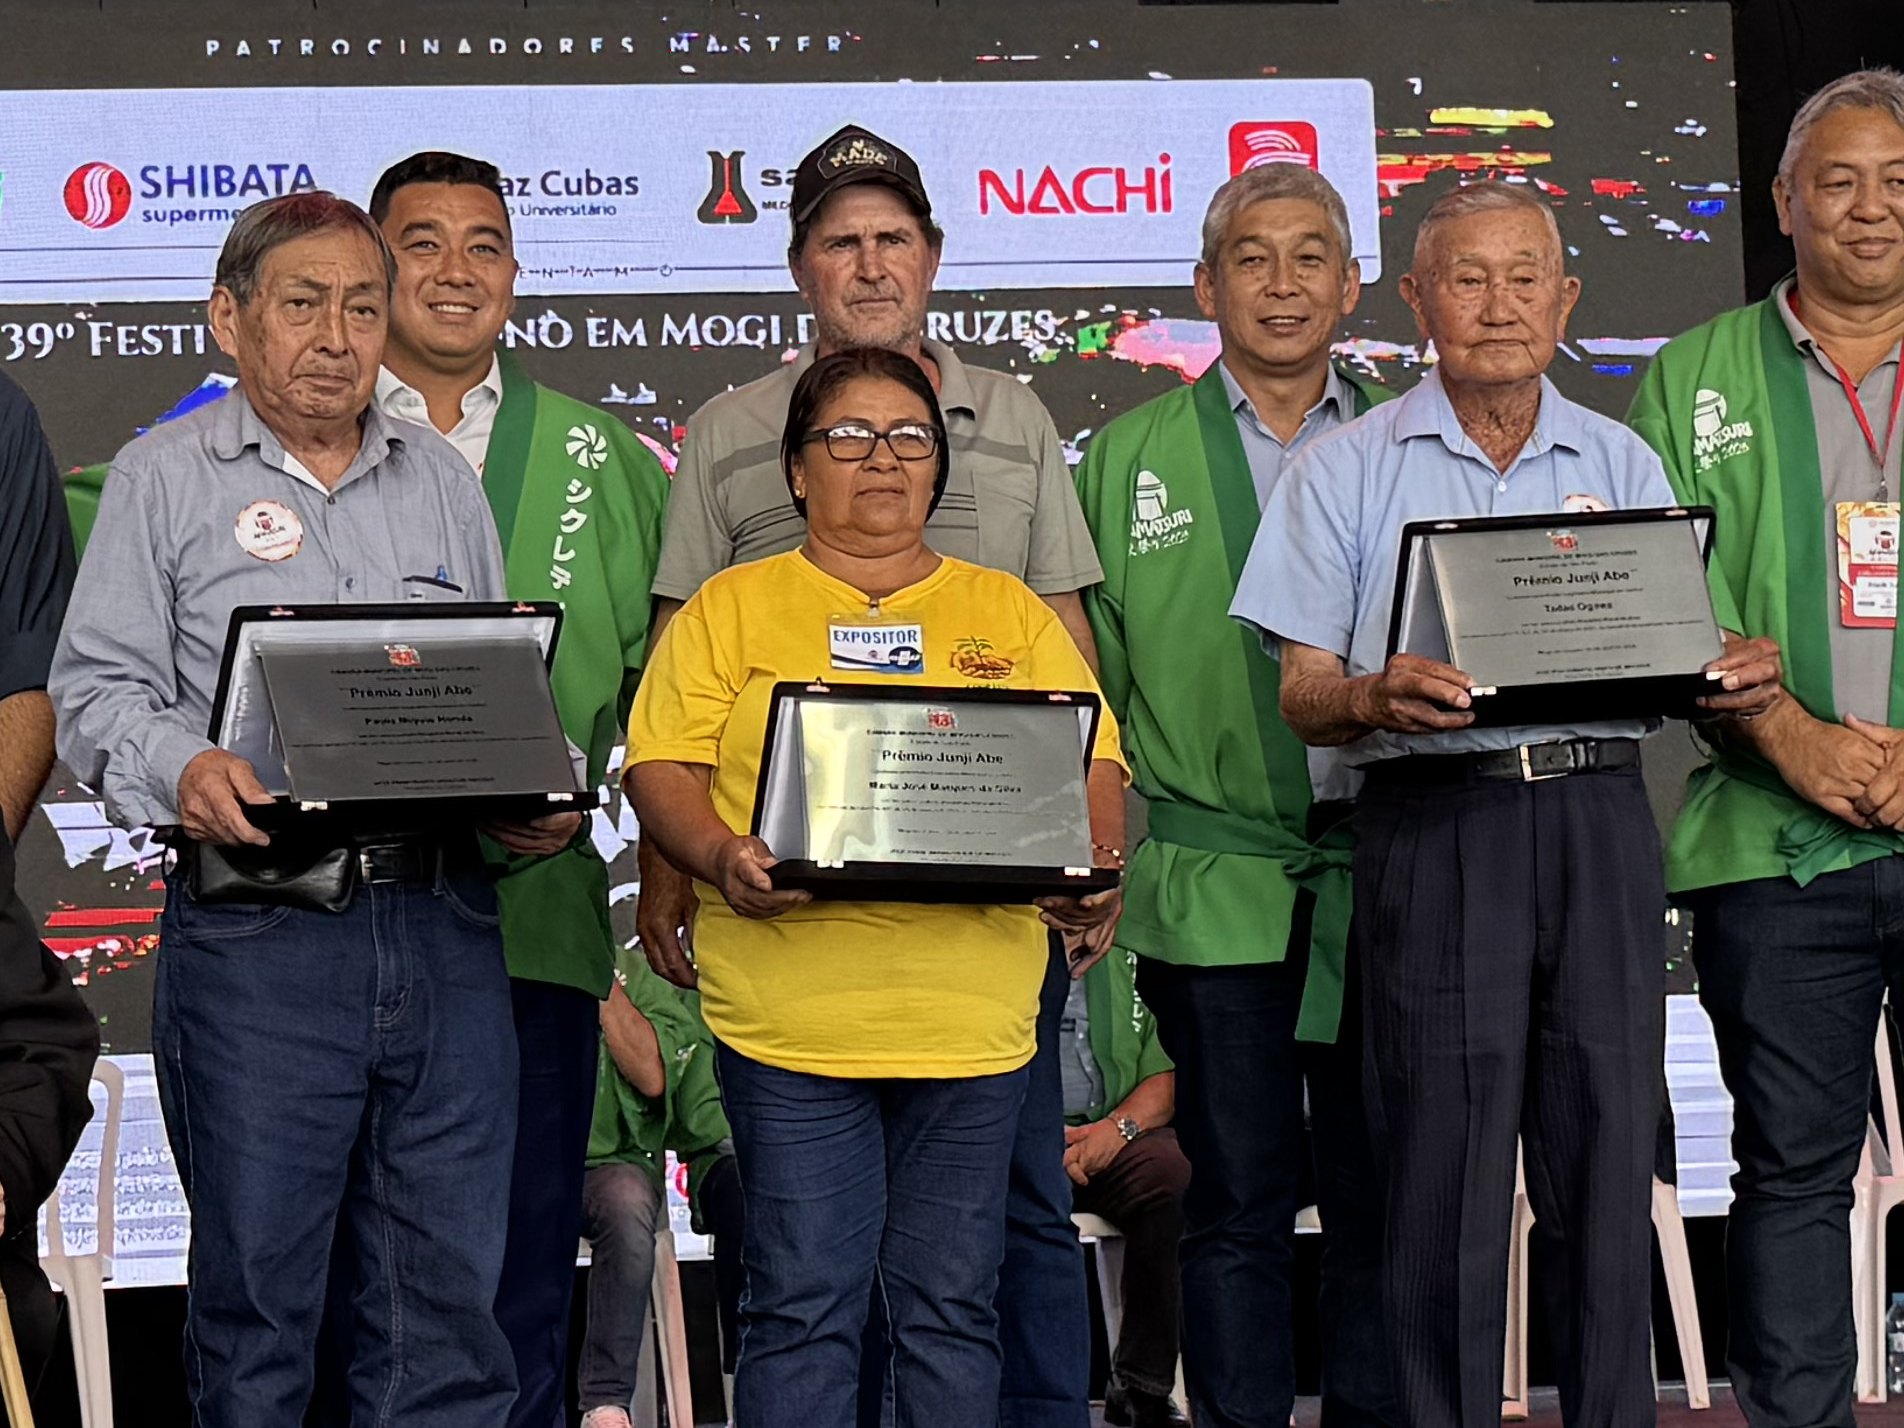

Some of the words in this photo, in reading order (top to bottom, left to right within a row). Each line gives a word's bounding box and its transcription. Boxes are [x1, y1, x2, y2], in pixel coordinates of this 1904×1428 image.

[140, 163, 318, 199] SHIBATA
[499, 176, 532, 196] az
[539, 168, 639, 197] Cubas
[142, 208, 242, 227] superme
[520, 202, 618, 217] Universitário
[519, 266, 629, 279] ENTAM
[86, 320, 207, 357] FESTI
[505, 313, 572, 349] NO
[587, 317, 648, 348] EM
[660, 313, 781, 349] MOGI
[927, 310, 1058, 344] RUZES
[833, 629, 918, 644] EXPOSITOR
